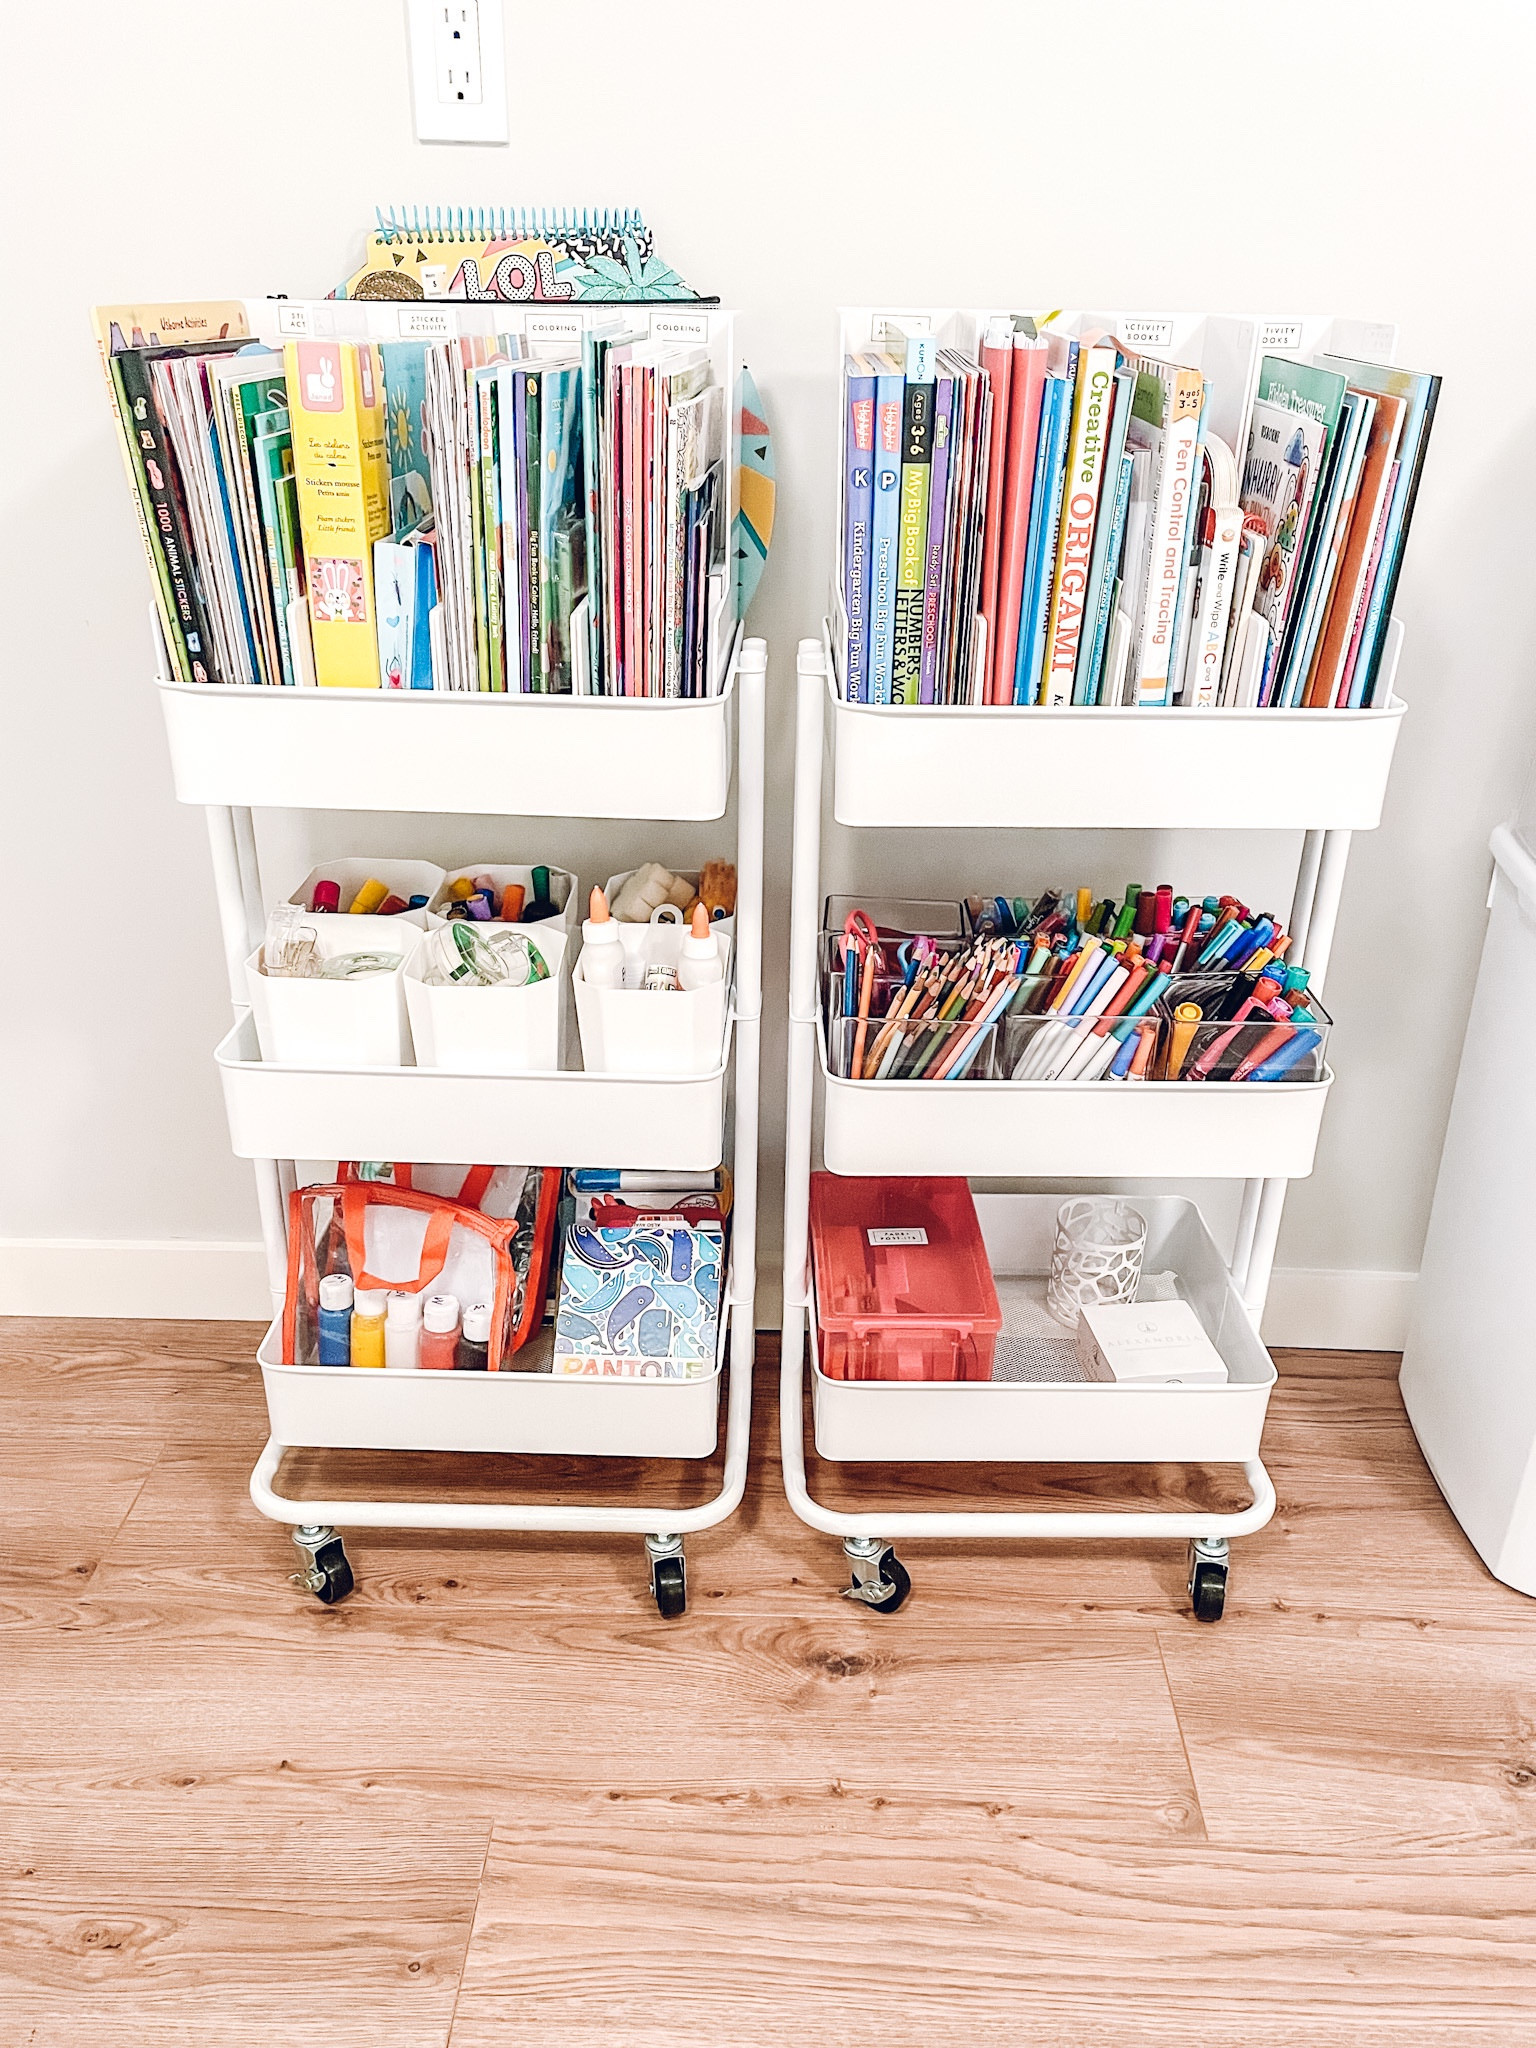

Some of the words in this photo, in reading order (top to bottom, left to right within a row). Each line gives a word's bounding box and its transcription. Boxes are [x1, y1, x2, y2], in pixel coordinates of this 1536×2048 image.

[459, 251, 576, 300] LOL
[656, 324, 702, 332] COLORING
[917, 343, 925, 380] KUMON
[914, 394, 924, 421] Ages
[1178, 389, 1200, 398] Ages
[1178, 398, 1199, 410] 3-5
[1268, 380, 1290, 411] Hidden
[1291, 390, 1326, 421] Treasures
[236, 417, 248, 453] DISCOVER
[482, 391, 491, 450] nickelodeon
[856, 401, 871, 450] Highlights
[882, 403, 899, 451] Highlights
[1080, 370, 1110, 484] Creative
[910, 425, 926, 456] 3-6
[1176, 438, 1192, 472] Pen
[306, 478, 334, 487] Stickers
[334, 480, 360, 488] mousse
[855, 469, 868, 488] K
[882, 472, 896, 491] P
[904, 470, 923, 495] My
[156, 502, 174, 533] 1000
[904, 498, 920, 524] Big
[1167, 477, 1188, 542] Control
[318, 524, 334, 532] Little
[530, 530, 538, 542] Big
[163, 535, 182, 577] ANIMAL
[904, 526, 920, 567] Book
[929, 544, 941, 572] Ready,
[851, 521, 866, 616] Kindergarten
[877, 538, 891, 606] Preschool
[904, 568, 918, 586] of
[1162, 548, 1179, 581] and
[1217, 552, 1230, 581] Write
[532, 576, 538, 584] to
[928, 573, 938, 590] Set,
[1052, 492, 1094, 674] ORIGAMI
[1216, 582, 1224, 598] and
[172, 578, 193, 622] STICKERS
[1209, 599, 1223, 629] Wipe
[848, 618, 862, 641] Big
[874, 608, 888, 631] Big
[1152, 584, 1175, 646] Tracing
[1363, 602, 1380, 639] MOANA
[875, 634, 886, 660] Fun
[906, 589, 924, 682] NUMBERS,
[1204, 631, 1220, 665] ABC
[850, 642, 862, 668] Fun
[894, 658, 906, 672] &
[1204, 667, 1212, 682] and
[1107, 1335, 1204, 1348] ALEXANDRIA
[563, 1357, 704, 1379] PANTONE
